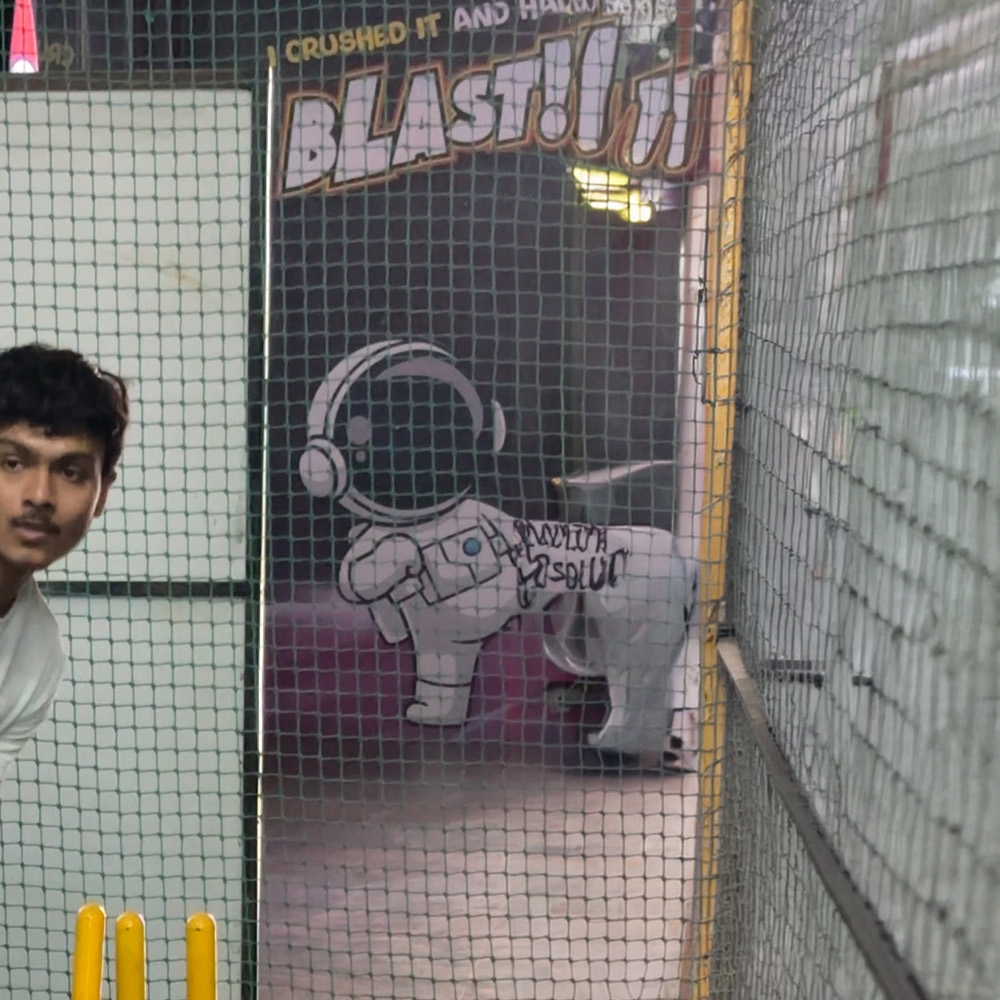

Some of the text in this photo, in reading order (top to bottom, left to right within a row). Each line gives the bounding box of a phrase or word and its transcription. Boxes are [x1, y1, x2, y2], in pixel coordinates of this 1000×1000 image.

[285, 20, 408, 64] CRUSHED
[415, 12, 442, 40] IT
[453, 2, 510, 32] AND
